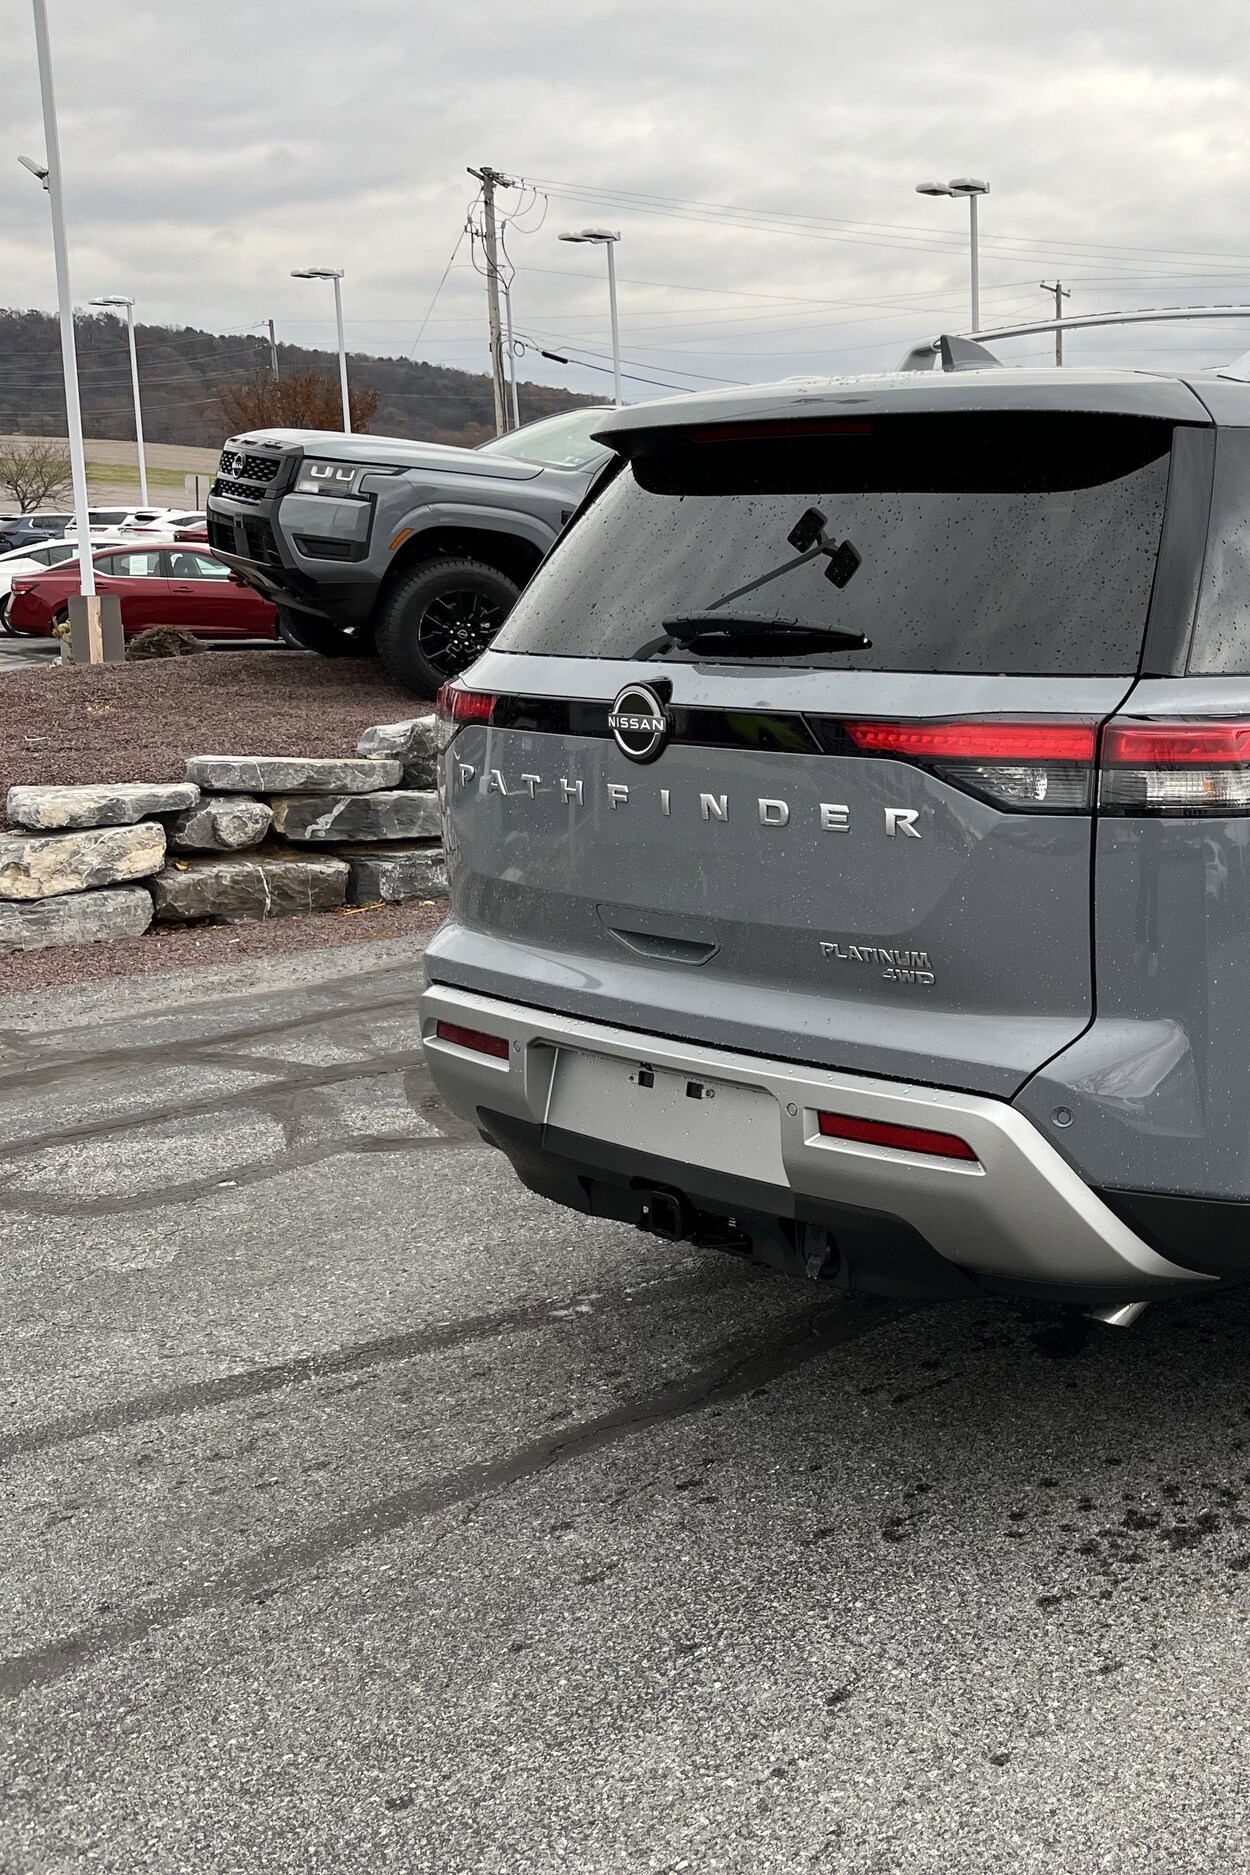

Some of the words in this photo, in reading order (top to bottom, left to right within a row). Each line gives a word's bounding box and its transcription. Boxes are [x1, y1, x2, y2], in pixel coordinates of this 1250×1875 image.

[608, 716, 664, 731] NISSAN
[458, 763, 922, 839] PATHFINDER
[819, 941, 934, 970] PLATINUM
[881, 968, 936, 985] 4WD
